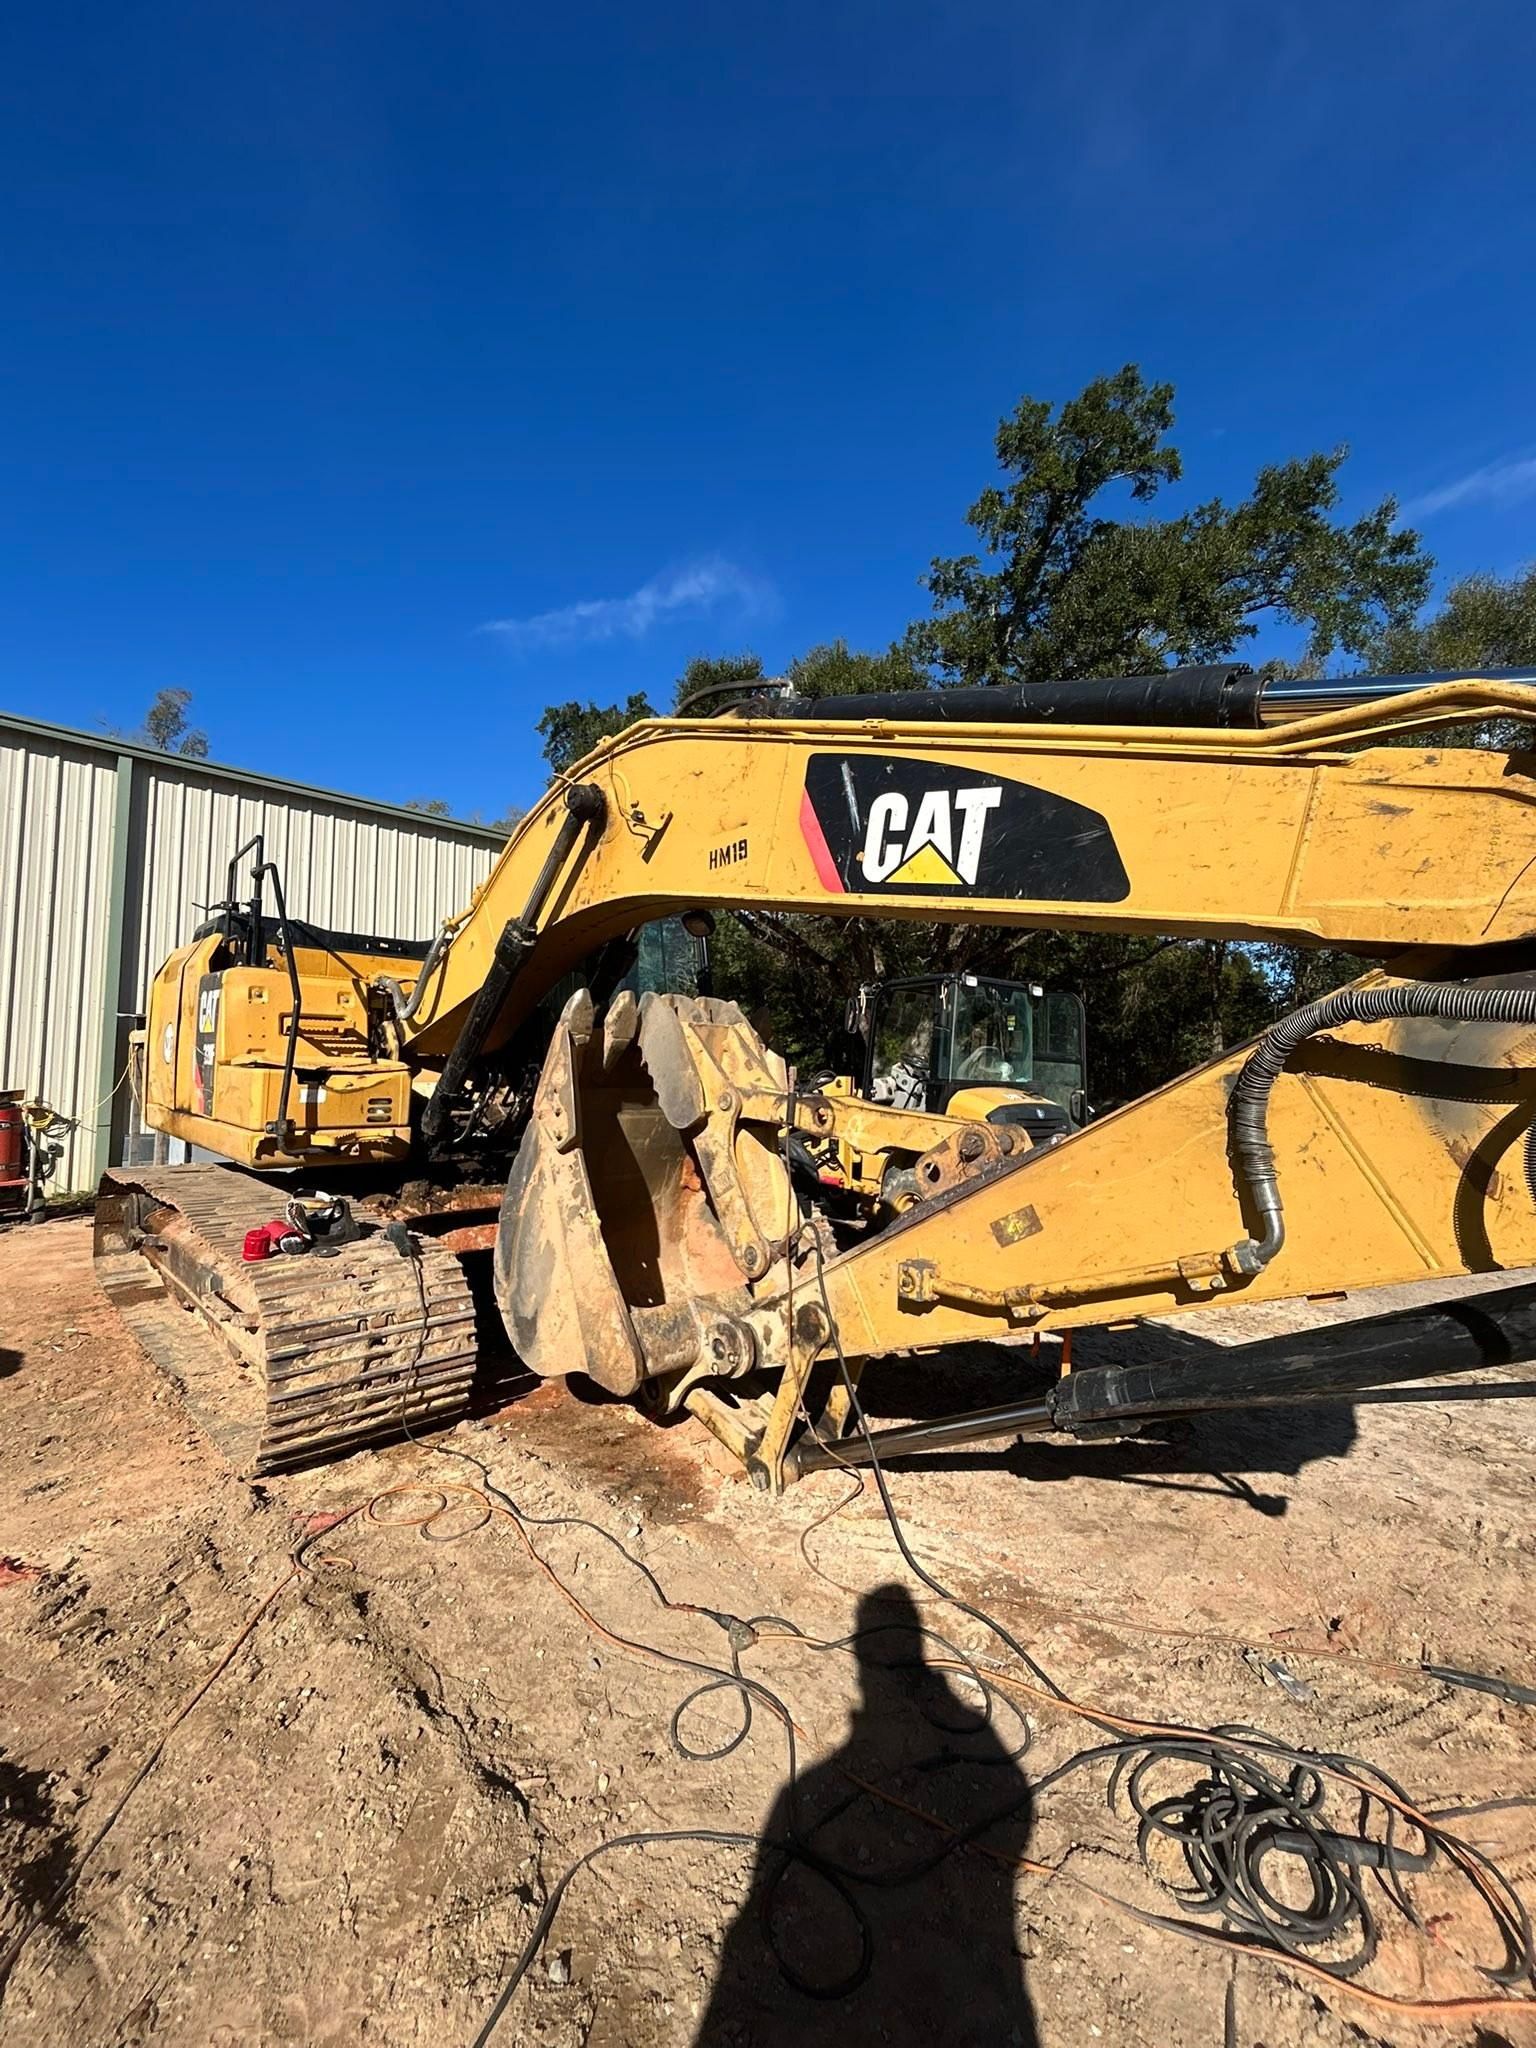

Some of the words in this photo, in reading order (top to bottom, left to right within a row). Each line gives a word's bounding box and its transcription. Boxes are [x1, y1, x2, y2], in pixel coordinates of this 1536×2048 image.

[709, 838, 748, 870] HM19
[861, 786, 1003, 885] CAT
[199, 989, 221, 1033] CAT
